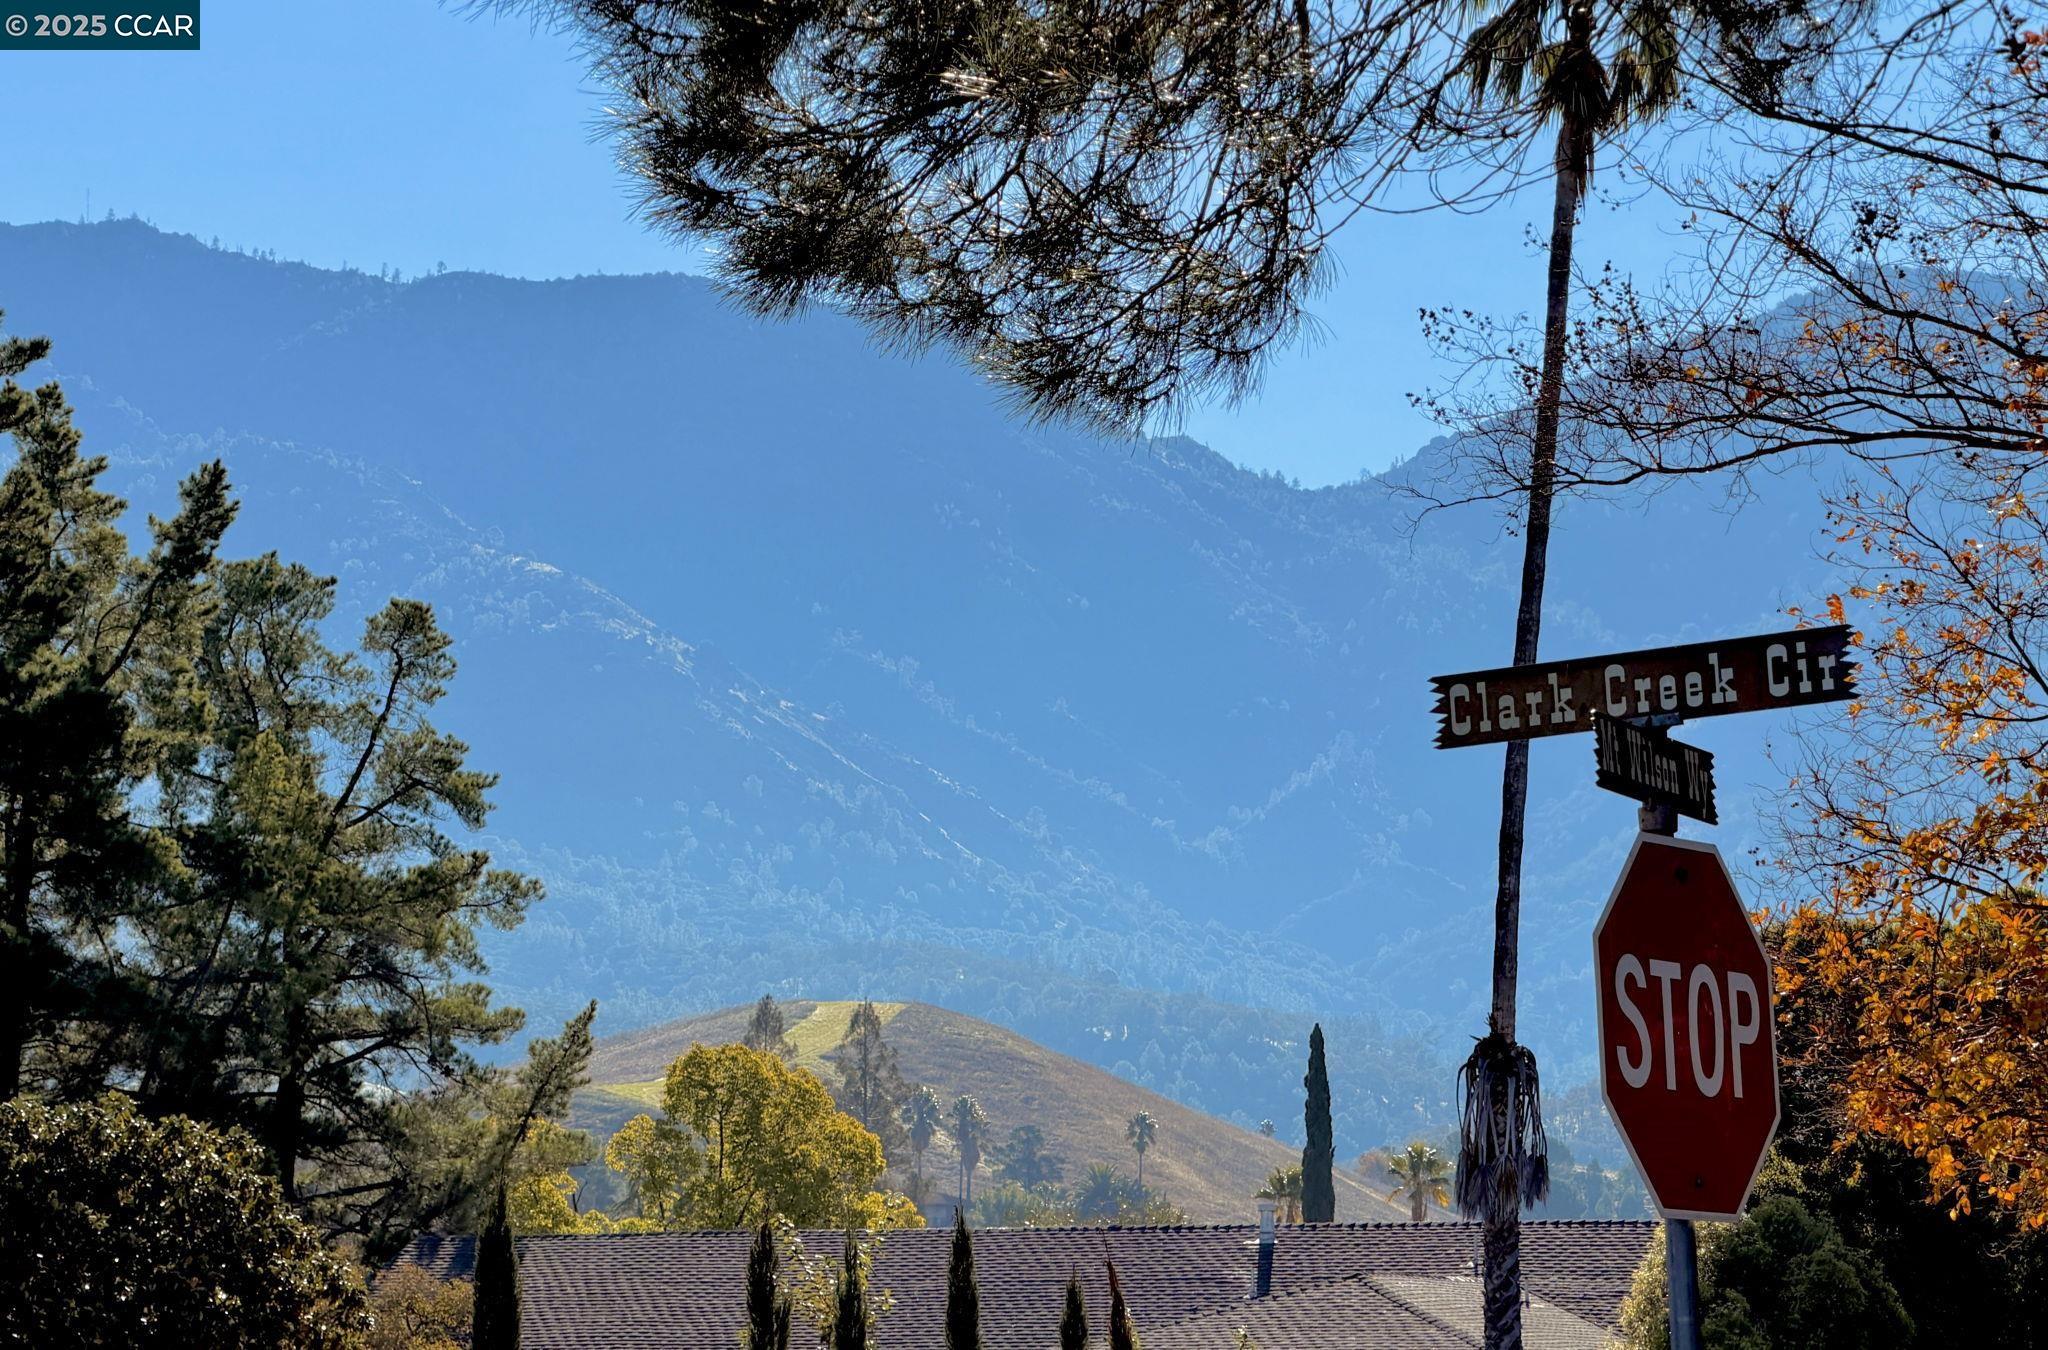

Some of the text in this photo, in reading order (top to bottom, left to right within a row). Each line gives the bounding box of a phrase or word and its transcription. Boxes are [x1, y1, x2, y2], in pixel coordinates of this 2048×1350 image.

[1449, 641, 1836, 736] Clark Creek Cir
[1600, 718, 1708, 819] Mt Wilson Wy
[1614, 953, 1761, 1099] STOP
